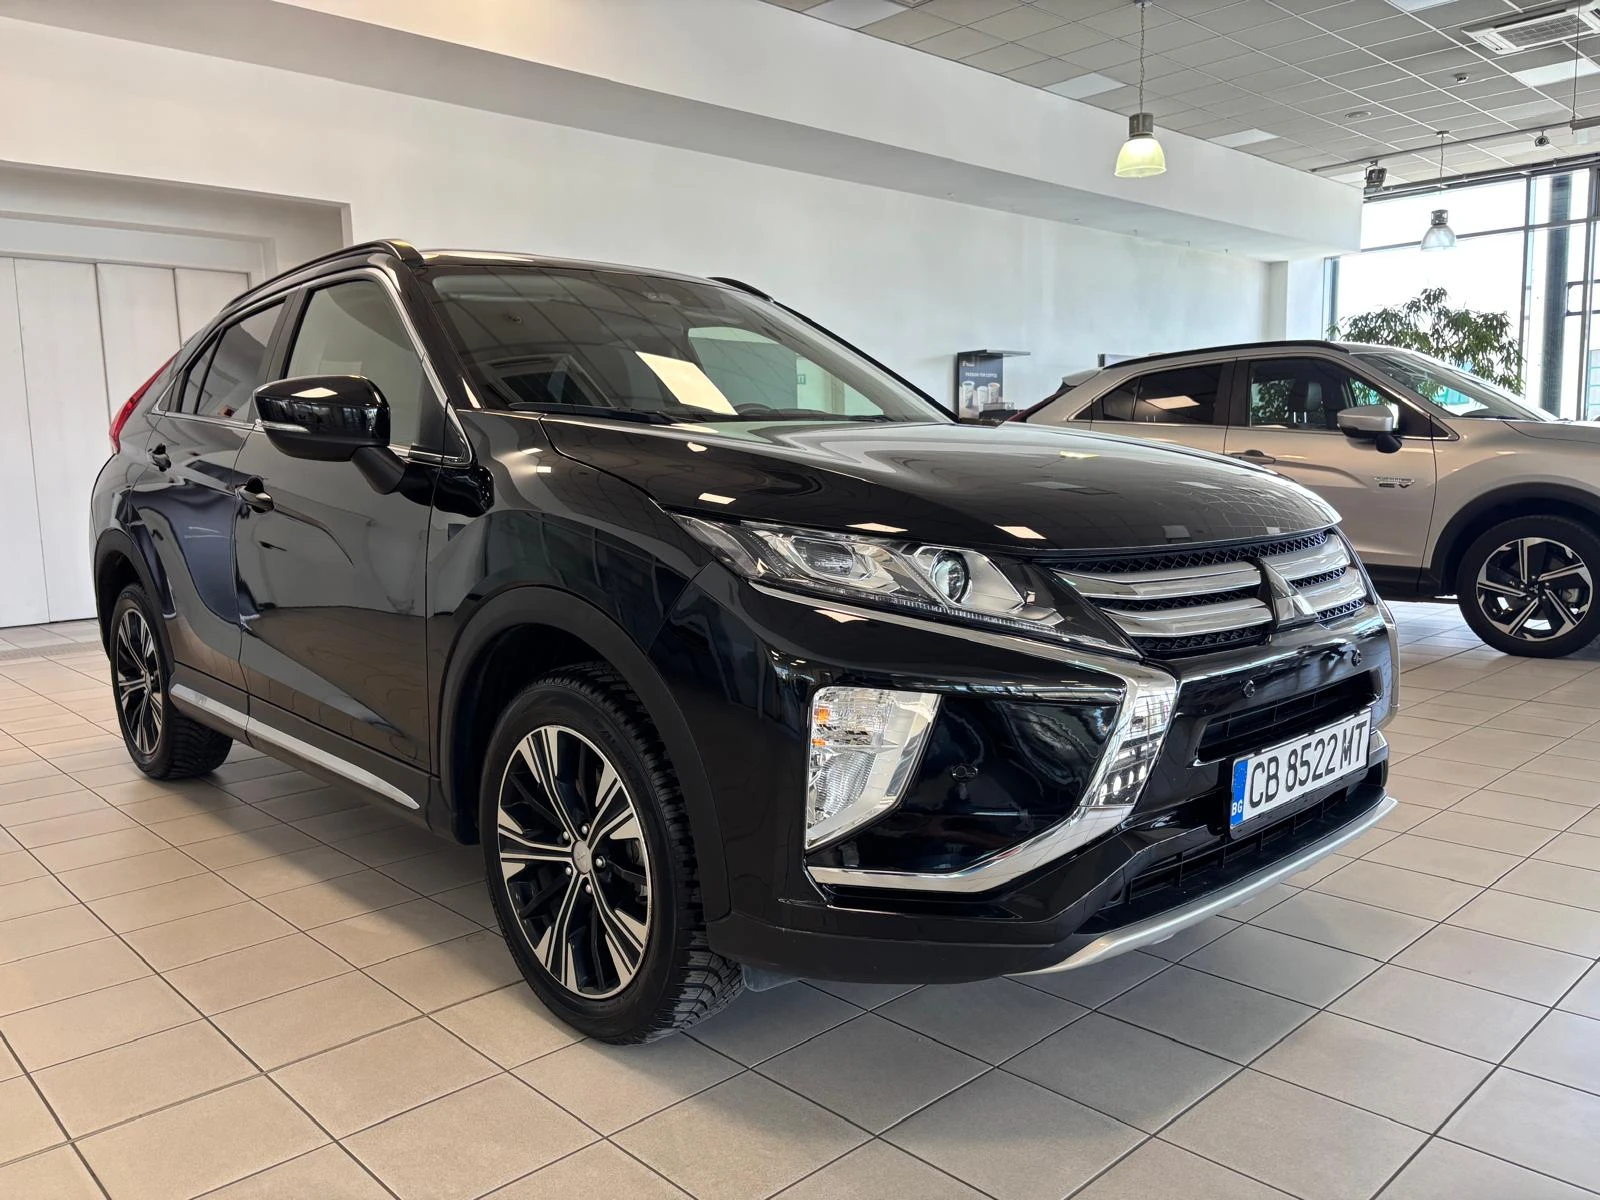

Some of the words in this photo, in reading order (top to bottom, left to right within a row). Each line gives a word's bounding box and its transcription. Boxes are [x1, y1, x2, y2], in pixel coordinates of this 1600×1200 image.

[1249, 755, 1280, 809] CB
[1285, 733, 1338, 793] 8522
[1339, 720, 1367, 770] MT
[1231, 799, 1243, 816] BG
